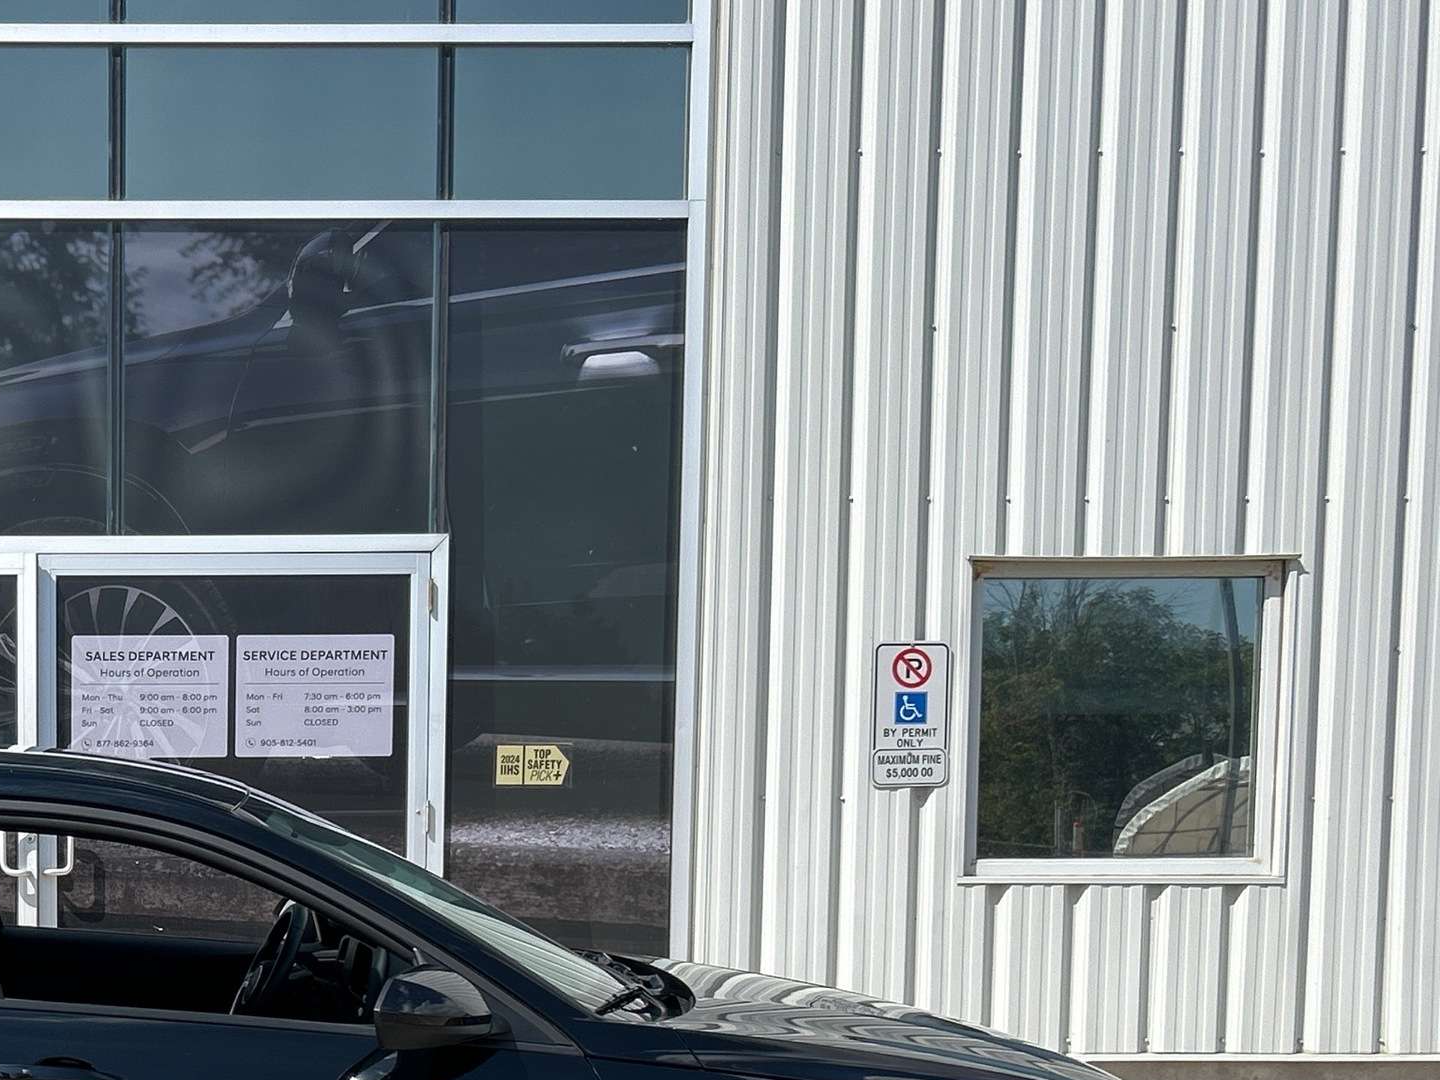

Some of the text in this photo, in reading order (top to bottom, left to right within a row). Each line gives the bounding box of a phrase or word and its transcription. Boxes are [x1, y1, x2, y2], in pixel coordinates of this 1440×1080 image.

[85, 651, 215, 662] SALES DEPARTMENT
[242, 649, 388, 661] SERVICE DEPARTMENT
[100, 668, 200, 679] Hours of Operation
[264, 667, 365, 678] Hours of Operation
[81, 693, 101, 701] Mon
[107, 693, 124, 701] Thu
[139, 693, 159, 701] 9:00
[182, 693, 202, 701] 8:00
[203, 694, 218, 703] pm
[366, 694, 381, 702] pm
[81, 706, 92, 714] Fri
[100, 706, 114, 714] Sat
[139, 706, 159, 714] 9:00
[203, 707, 218, 716] pm
[367, 707, 382, 715] pm
[81, 719, 174, 727] Sun CLOSED
[883, 727, 938, 738] BY PERMIT
[896, 738, 924, 748] ONLY
[500, 754, 520, 763] 2024
[533, 749, 552, 759] TOP
[527, 759, 563, 769] SAFETY
[877, 754, 942, 765] MAXIMUM FINE
[500, 765, 520, 776] IIHS
